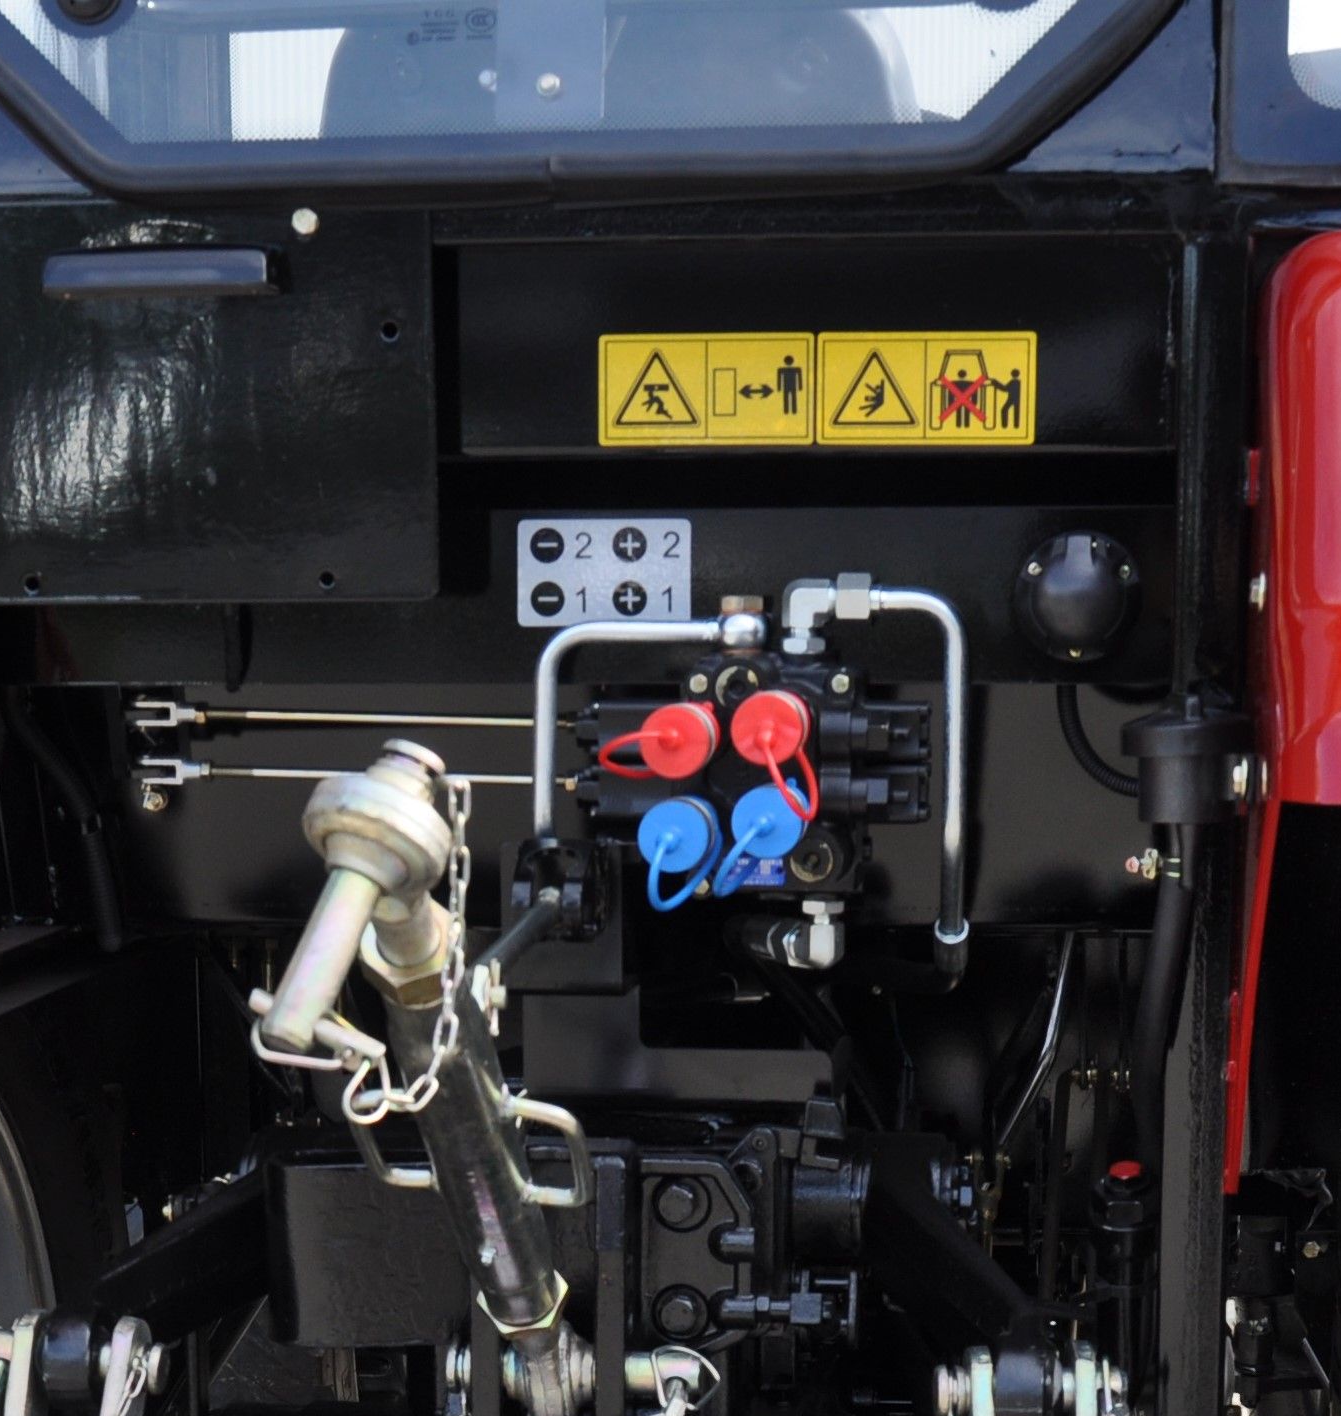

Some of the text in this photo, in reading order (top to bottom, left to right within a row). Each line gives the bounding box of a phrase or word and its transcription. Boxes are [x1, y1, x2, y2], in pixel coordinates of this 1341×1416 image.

[575, 531, 680, 559] 2 2
[576, 586, 672, 613] 1 1
